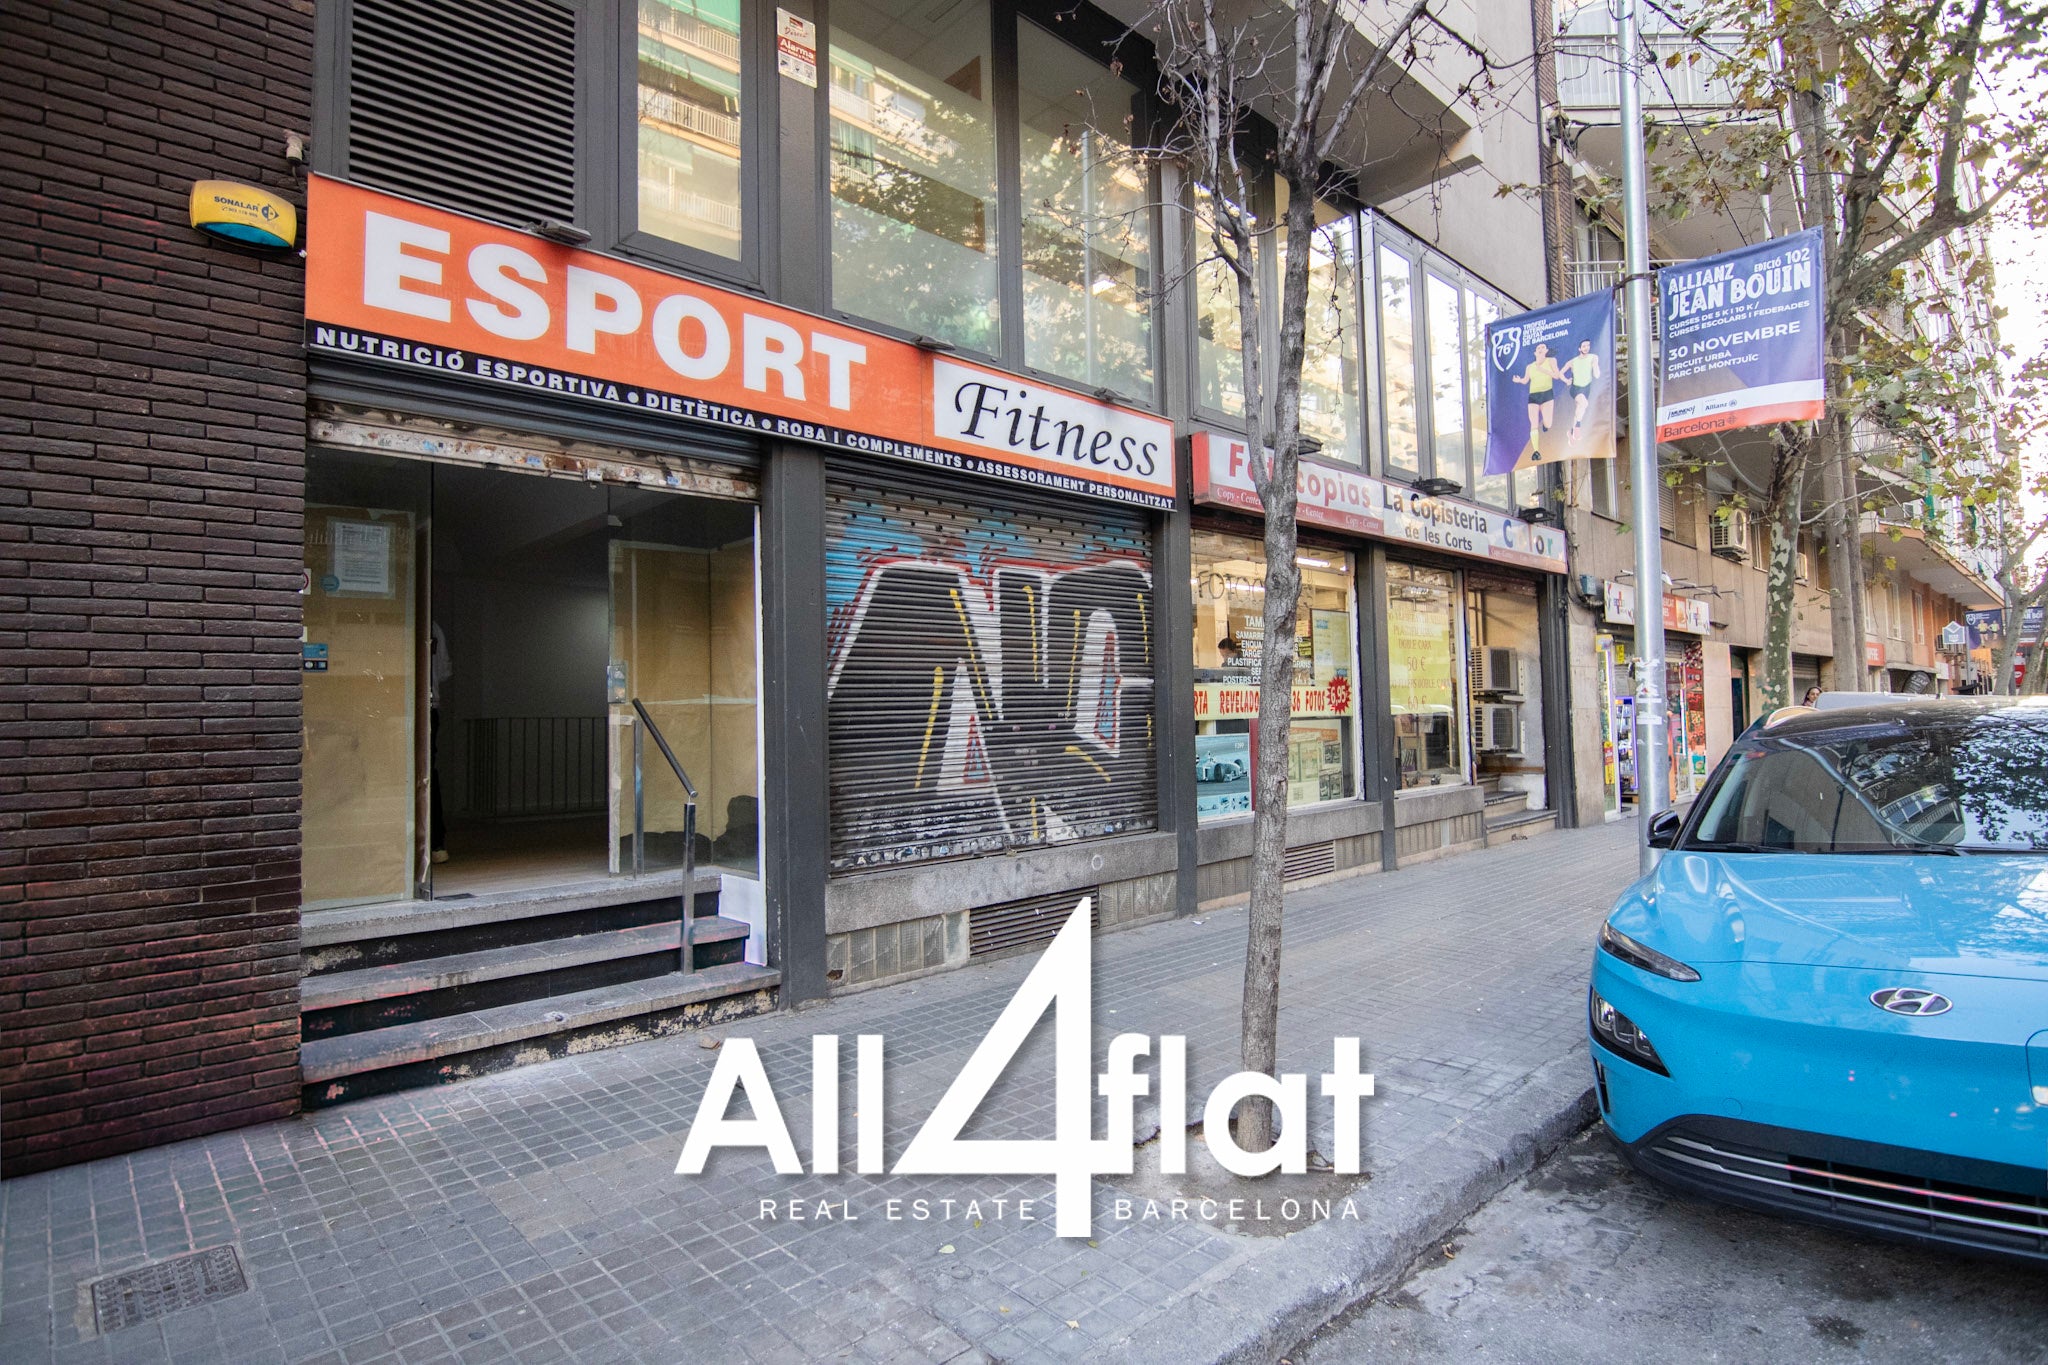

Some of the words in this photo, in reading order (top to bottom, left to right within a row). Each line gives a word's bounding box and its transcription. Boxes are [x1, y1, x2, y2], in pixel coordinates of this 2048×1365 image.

[780, 38, 814, 59] Alarma
[214, 196, 259, 212] SONALAR
[1754, 256, 1782, 272] EDICIÓ
[1784, 247, 1810, 264] 102
[1668, 263, 1735, 295] ALLIANZ
[1668, 281, 1724, 321] JEAN
[1730, 260, 1811, 304] BOUIN
[364, 210, 867, 411] ESPORT
[1669, 316, 1700, 331] CURSES
[1701, 312, 1713, 321] DE
[1722, 308, 1729, 316] K
[1669, 324, 1700, 339] CURSES
[1701, 312, 1747, 329] ESCOLARS
[1753, 300, 1810, 317] FEDERADES
[1523, 319, 1547, 330] TROFEU
[1523, 318, 1571, 335] INTERNACIONAL
[1523, 331, 1543, 341] CIUTAT
[1532, 329, 1569, 345] BARCELONA
[1668, 346, 1688, 361] 30
[1693, 320, 1801, 354] NOVEMBRE
[1668, 357, 1703, 372] CIRCUIT
[1704, 350, 1732, 362] URBÀ
[1668, 368, 1692, 381] PARC
[1694, 364, 1707, 374] DE
[1708, 353, 1759, 370] MONTJUÏC
[316, 326, 464, 371] NUTRICIÓ
[477, 358, 620, 402] ESPORTIVA
[645, 392, 756, 428] DIETÈTICA
[777, 419, 827, 442] ROBA
[834, 431, 839, 444] I
[846, 433, 962, 469] COMPLEMENTS
[976, 460, 1085, 492] ASSESSORAMENT
[1089, 482, 1173, 509] PERSONALITZAT
[1705, 402, 1728, 411] Allianz
[954, 382, 1158, 476] Fitness
[1664, 418, 1725, 438] Barcelona
[1217, 487, 1235, 502] Copy
[1383, 484, 1404, 513] La
[1411, 493, 1487, 534] Copisteria
[1405, 521, 1419, 539] de
[1424, 526, 1440, 544] les
[1445, 532, 1473, 551] Corts
[1305, 690, 1326, 712] FOTOS
